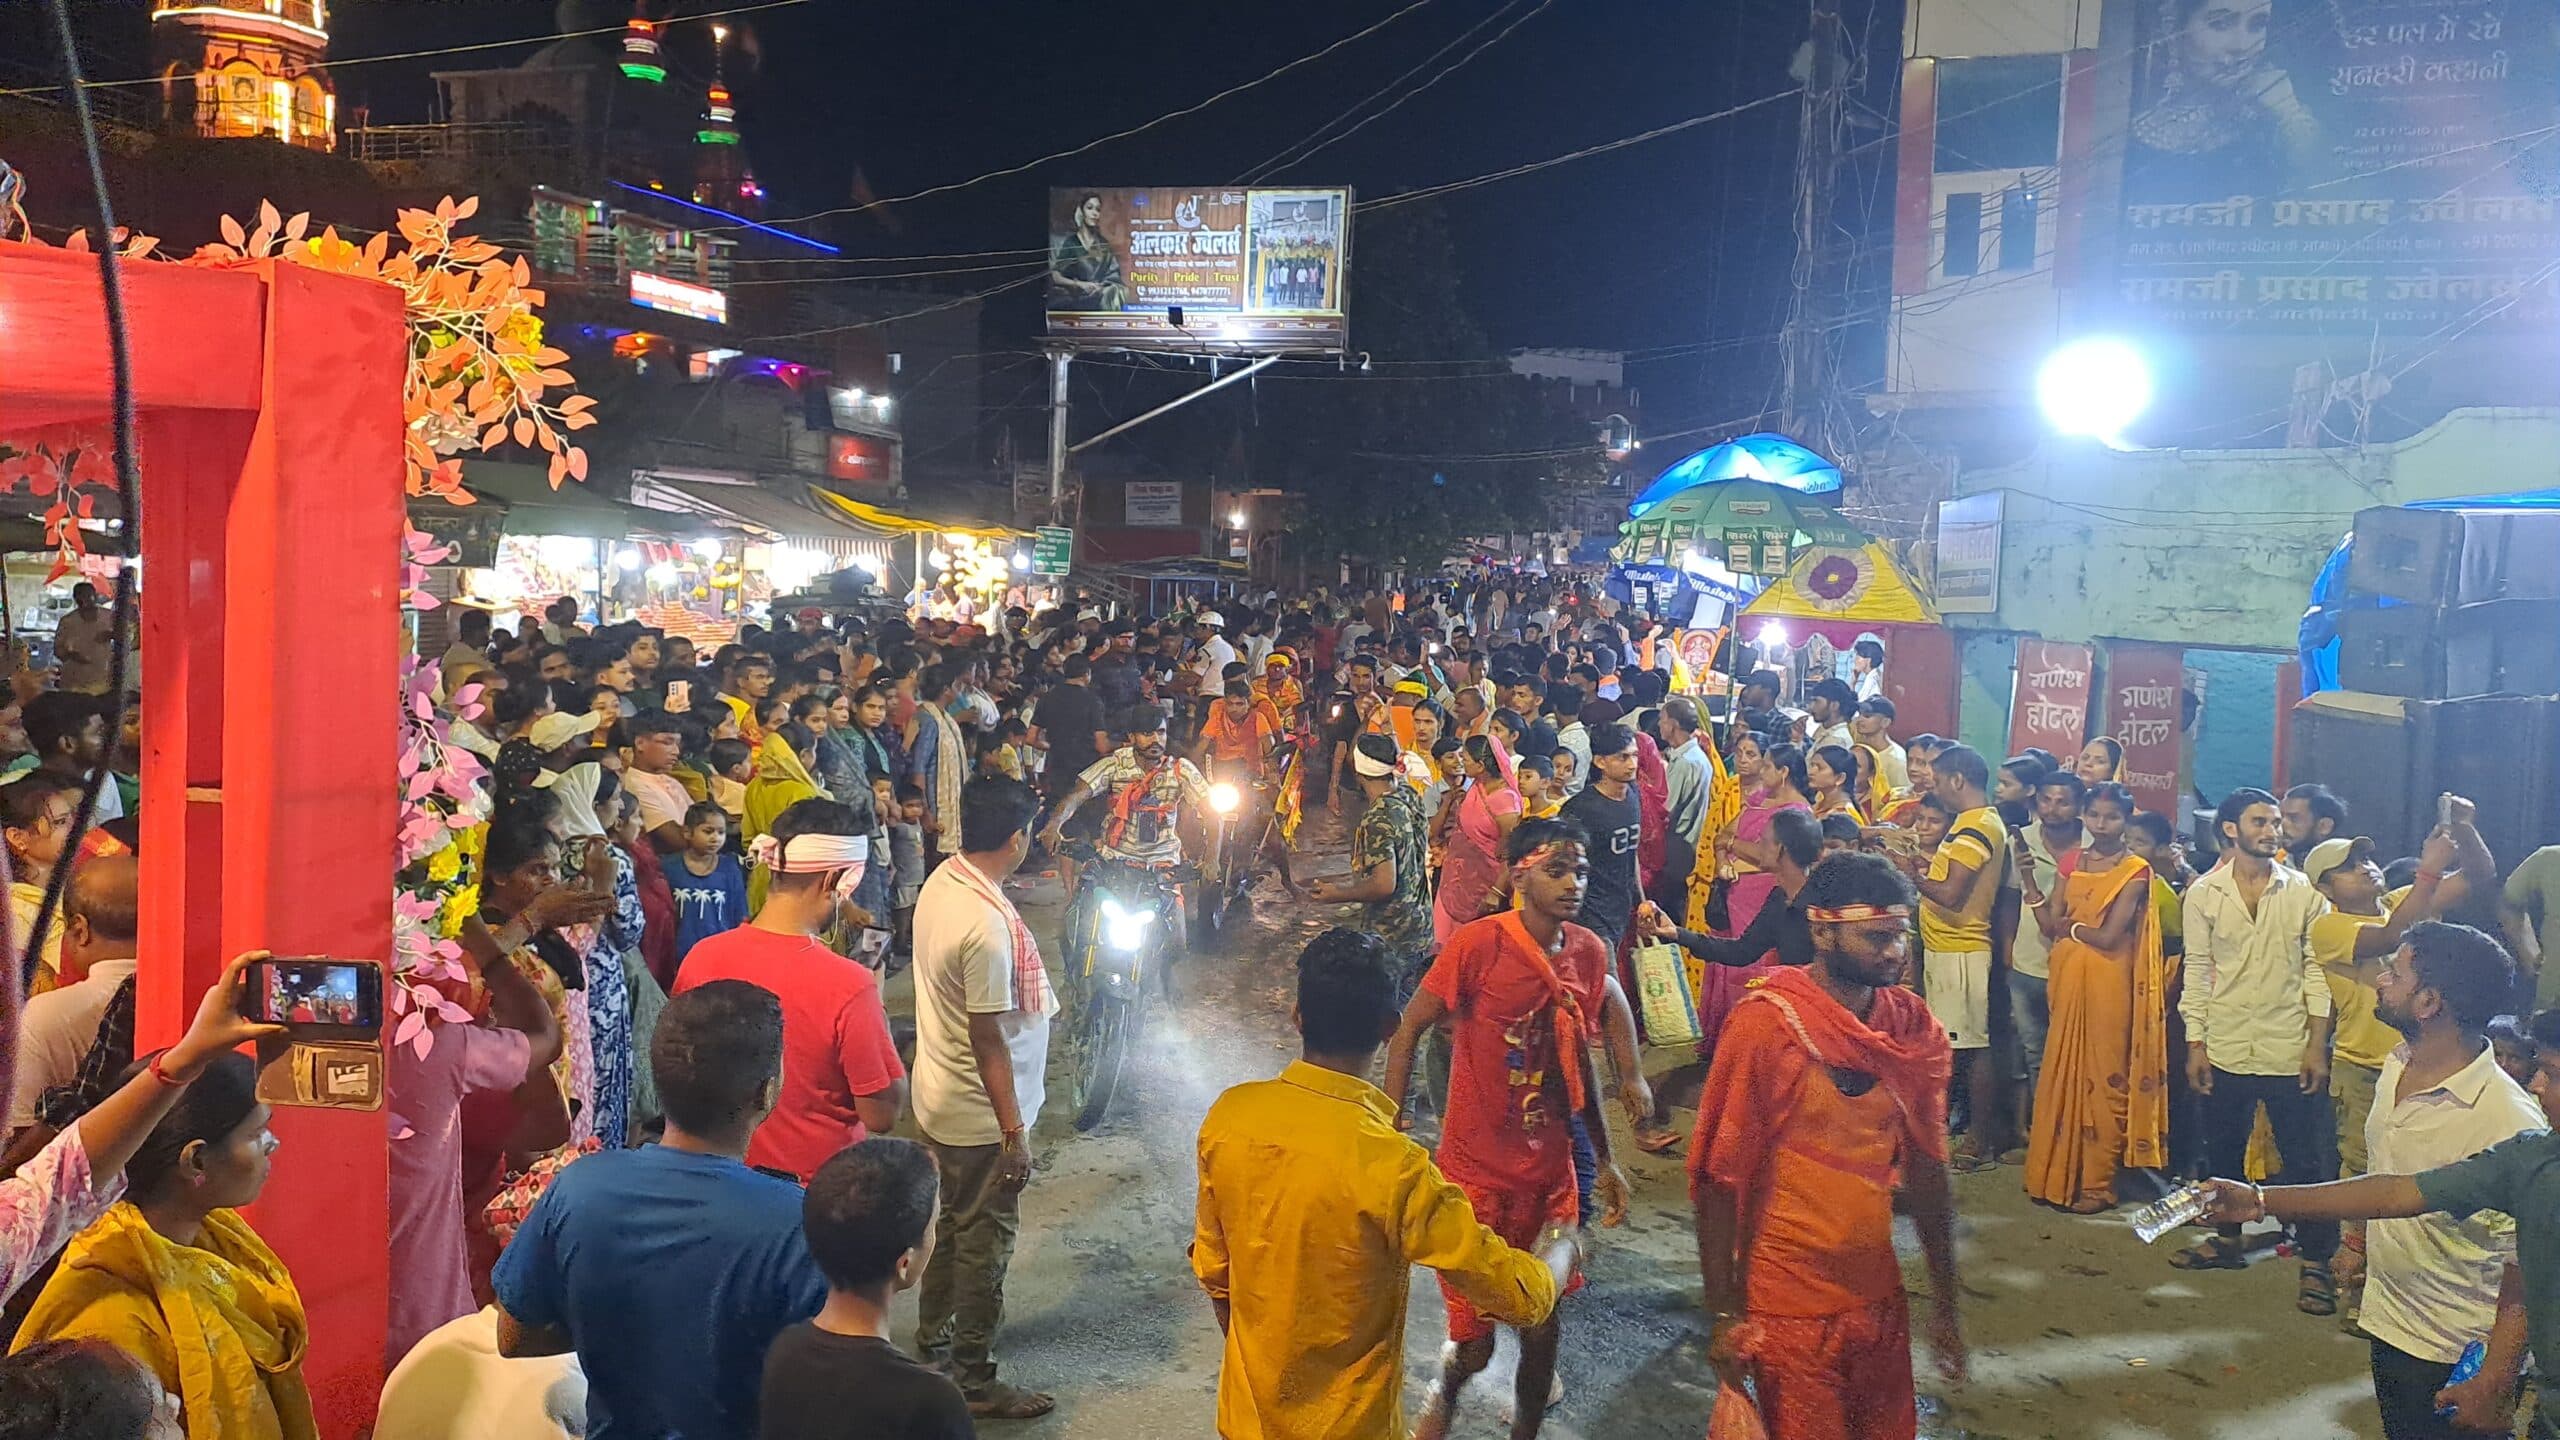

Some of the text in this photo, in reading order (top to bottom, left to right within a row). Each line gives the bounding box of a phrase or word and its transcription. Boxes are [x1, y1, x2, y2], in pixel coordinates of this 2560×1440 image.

[2388, 21, 2426, 44] पल
[2435, 12, 2458, 43] में
[2328, 50, 2509, 97] सुनहरी कहानी
[2127, 195, 2254, 230] रामजी
[2272, 198, 2393, 228] प्रसाद
[1129, 223, 1242, 255] अलंकार ज्वेलर्स
[1130, 271, 1240, 284] Purity Pride Trust
[2120, 269, 2245, 304] रामजी
[2255, 274, 2372, 304] प्रसाद
[2028, 662, 2084, 689] गणेश
[2119, 678, 2173, 709] गणेश
[2024, 695, 2082, 740] होटल
[2117, 712, 2172, 748] होटल
